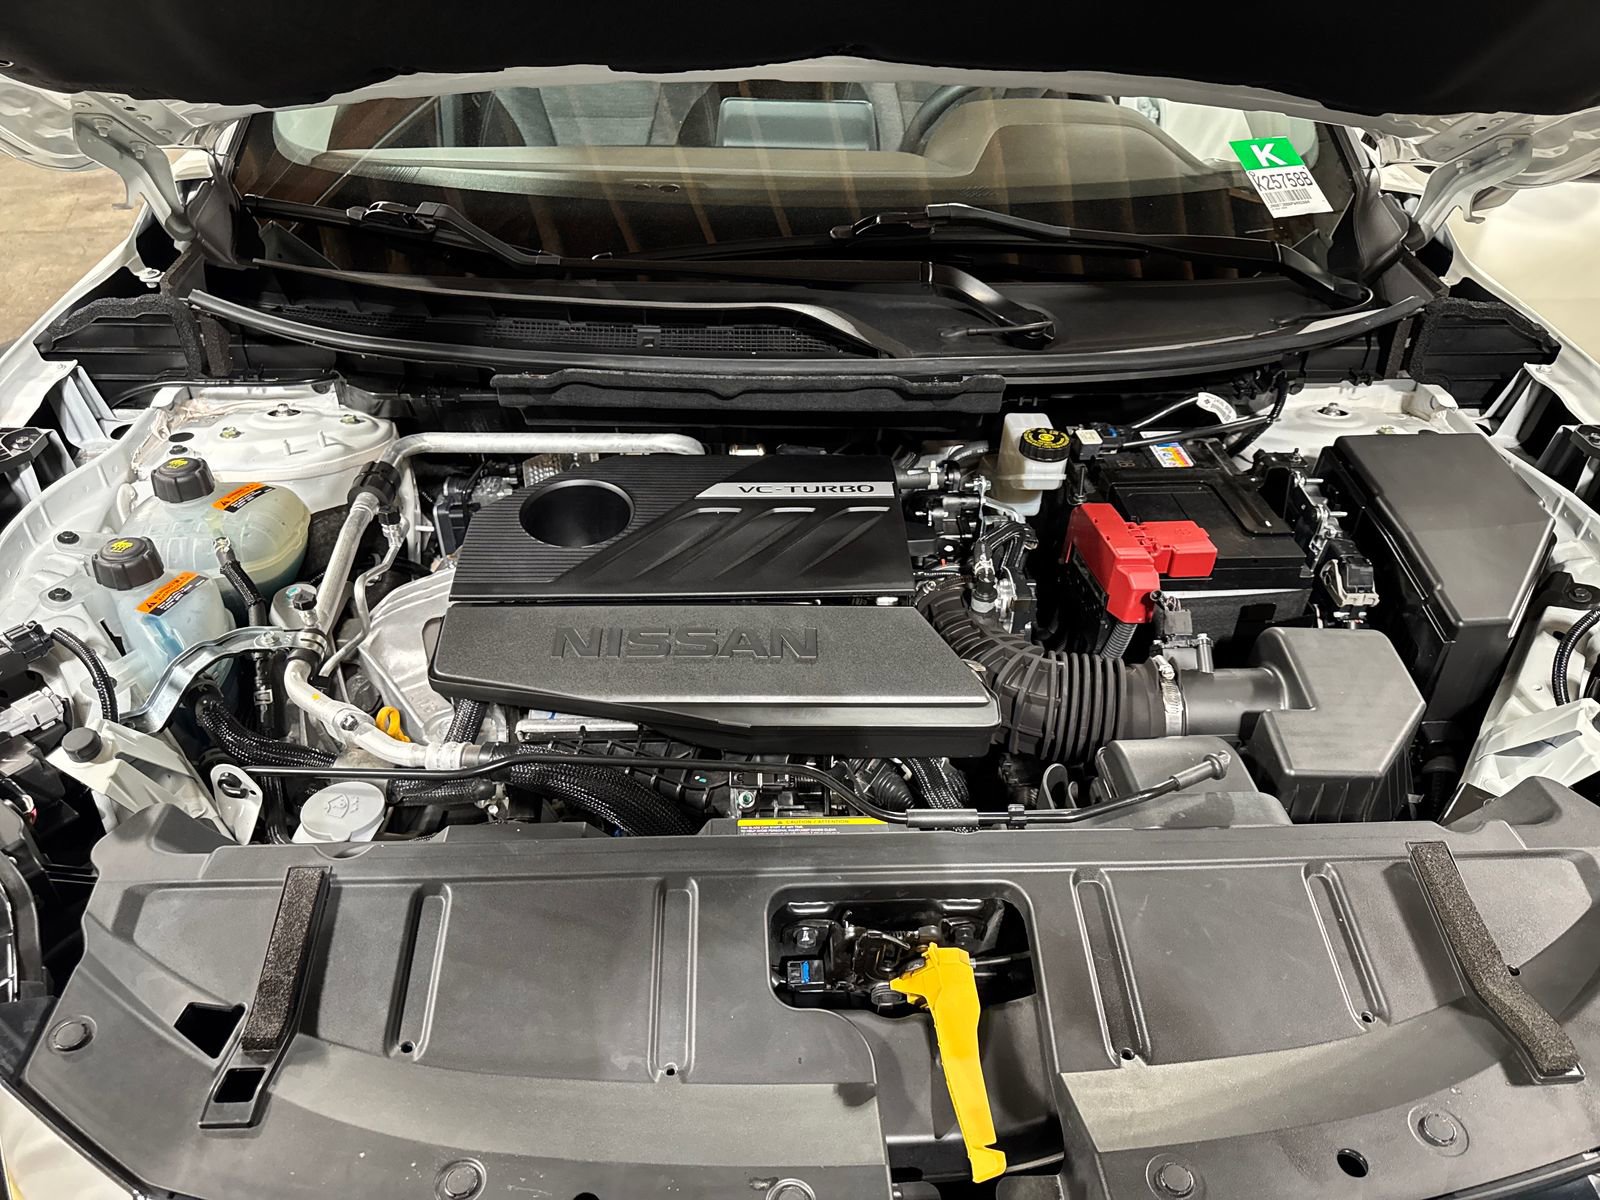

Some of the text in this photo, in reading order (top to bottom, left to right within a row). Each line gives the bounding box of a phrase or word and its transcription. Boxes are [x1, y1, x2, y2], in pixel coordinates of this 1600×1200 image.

[1250, 143, 1288, 167] K
[1252, 171, 1313, 191] K25758B
[738, 484, 875, 494] VC-TURBO
[550, 627, 818, 660] NISSAN
